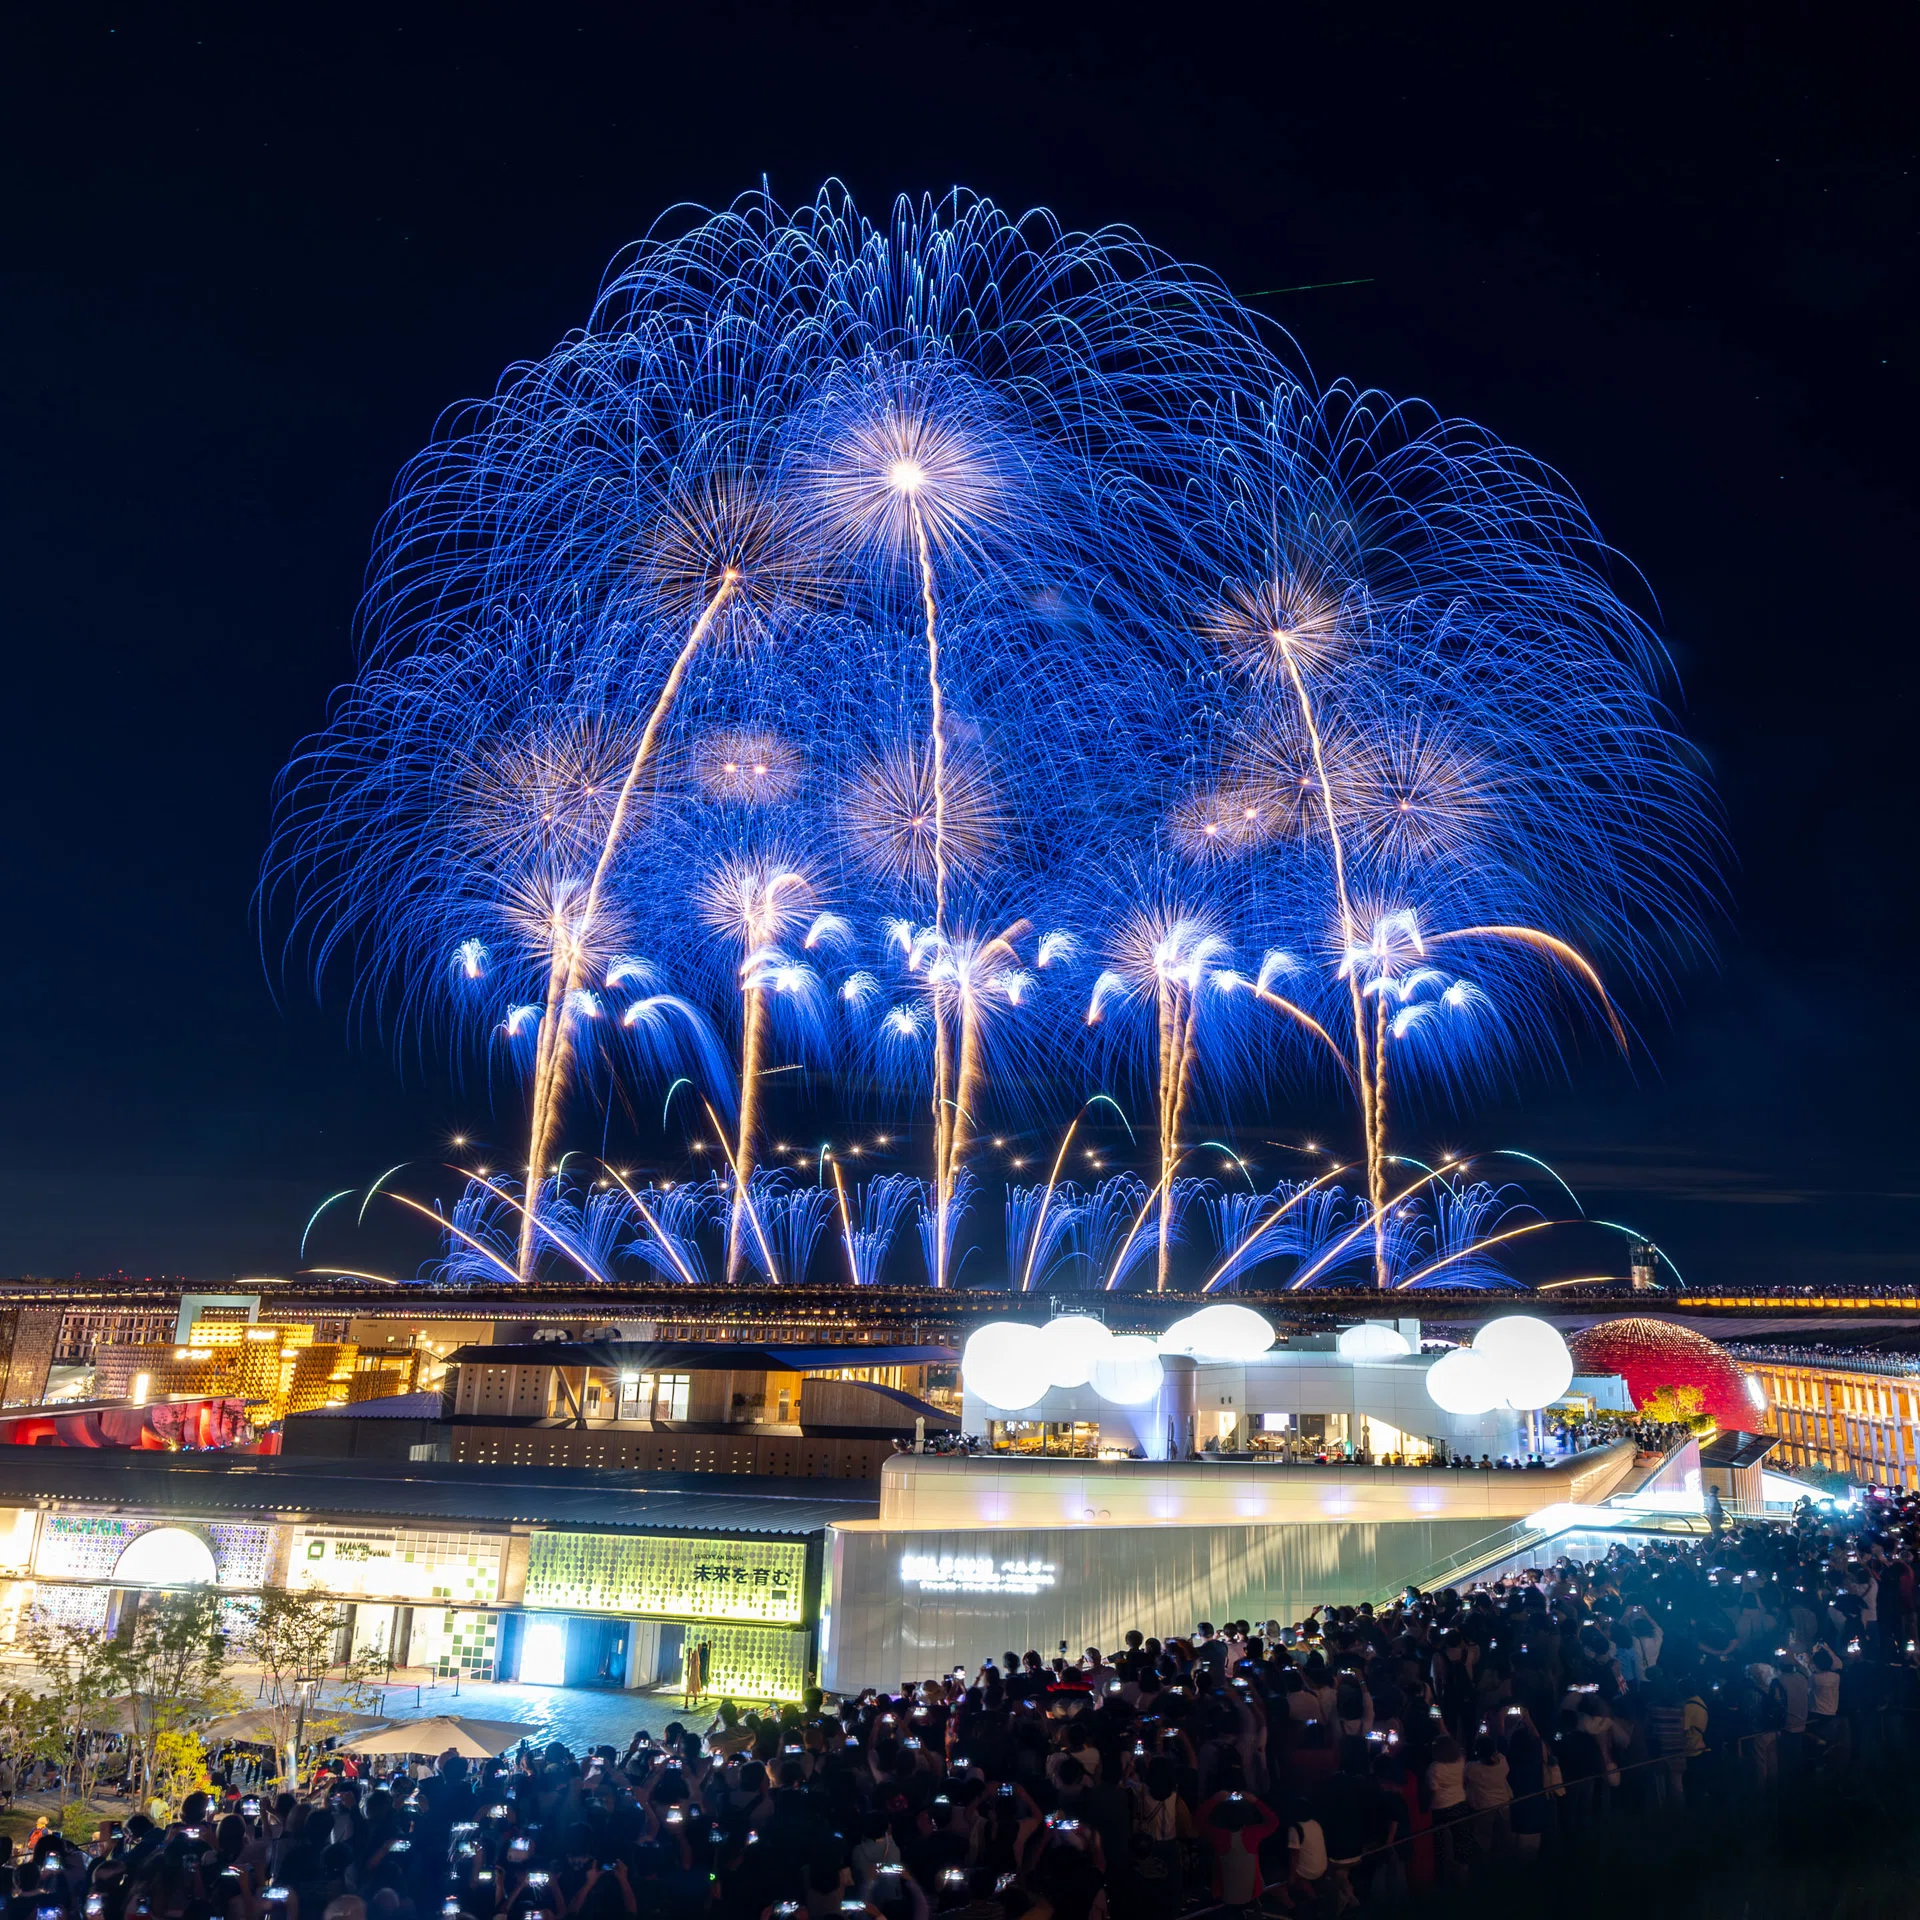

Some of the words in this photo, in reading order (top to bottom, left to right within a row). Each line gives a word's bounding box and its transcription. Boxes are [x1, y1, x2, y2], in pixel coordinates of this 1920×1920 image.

[693, 1564, 791, 1586] 未来を育む
